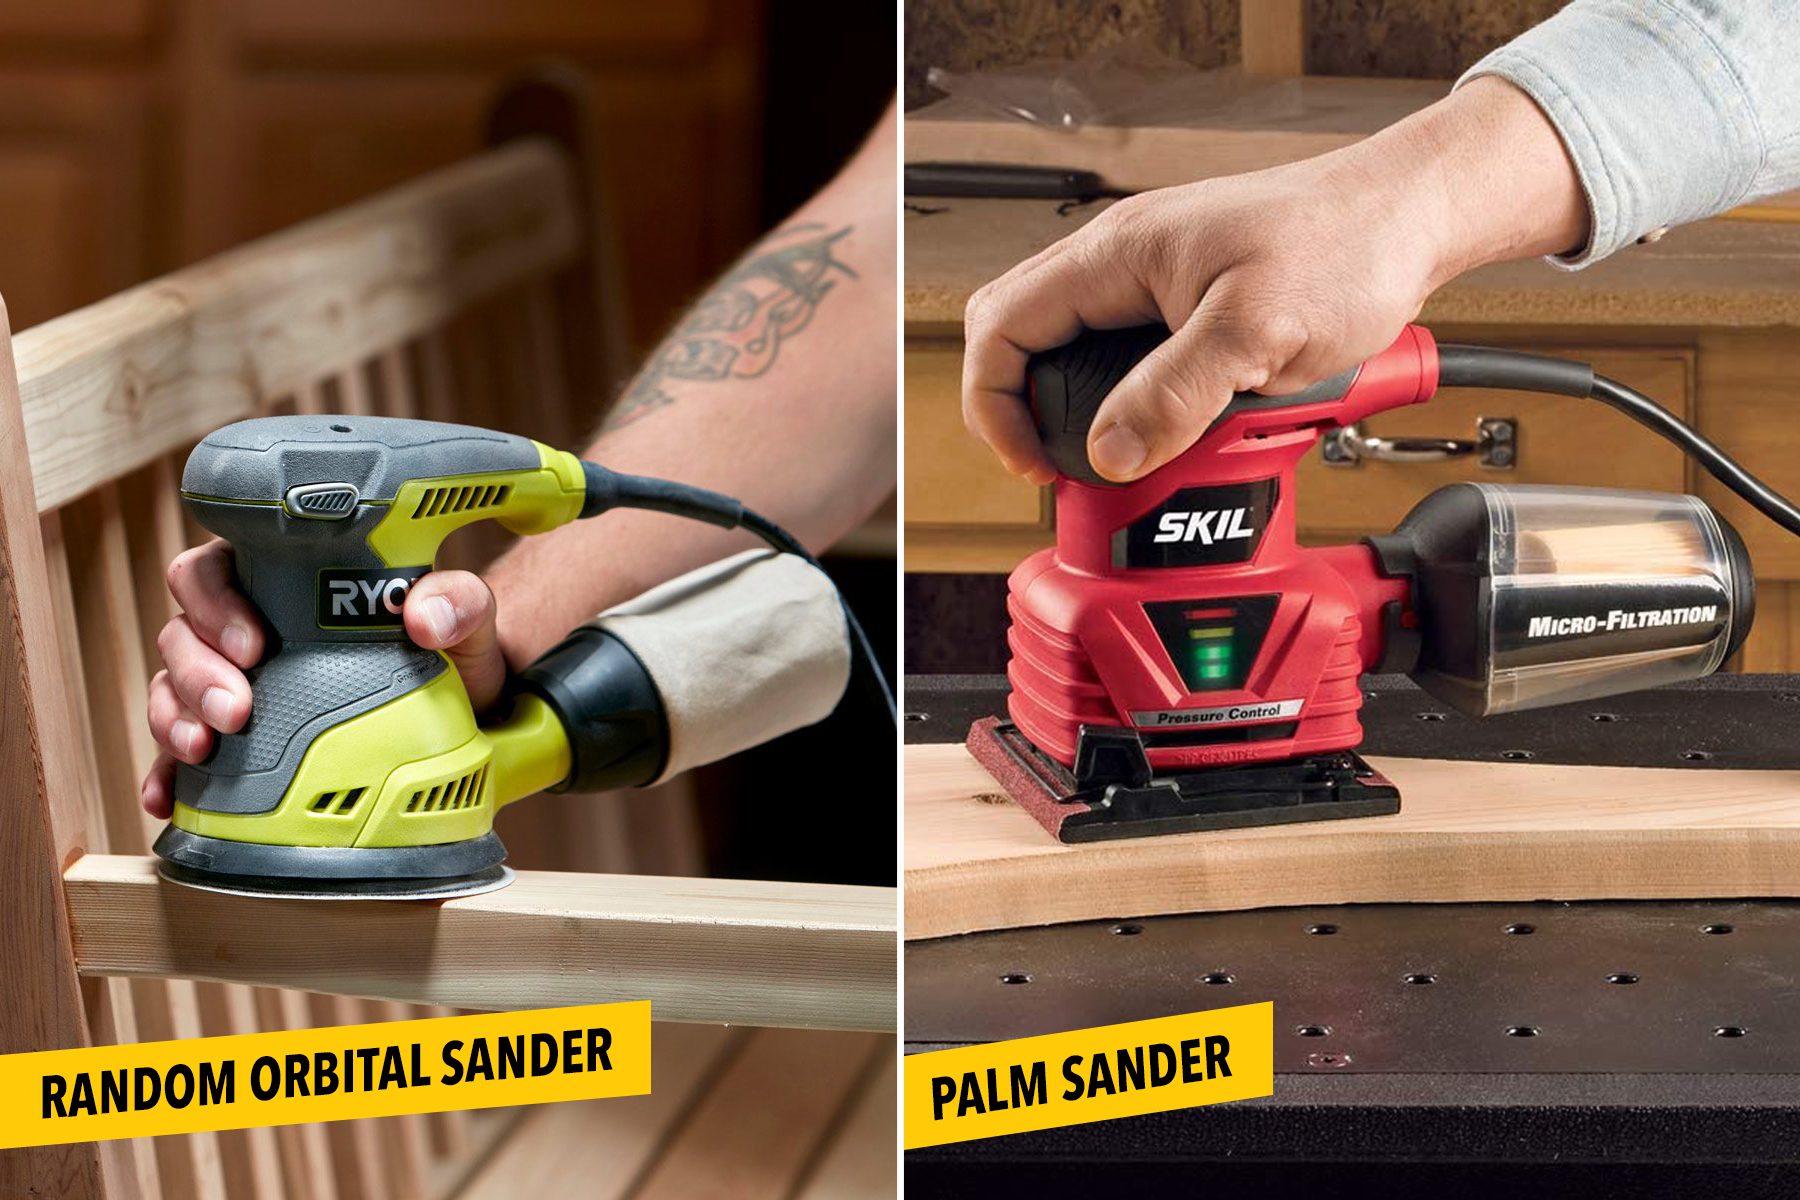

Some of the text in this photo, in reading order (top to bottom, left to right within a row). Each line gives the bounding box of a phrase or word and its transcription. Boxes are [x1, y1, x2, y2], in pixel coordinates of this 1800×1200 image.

[1153, 507, 1255, 546] SKIL
[328, 577, 418, 616] RYO
[1157, 704, 1281, 725] Pressure Control
